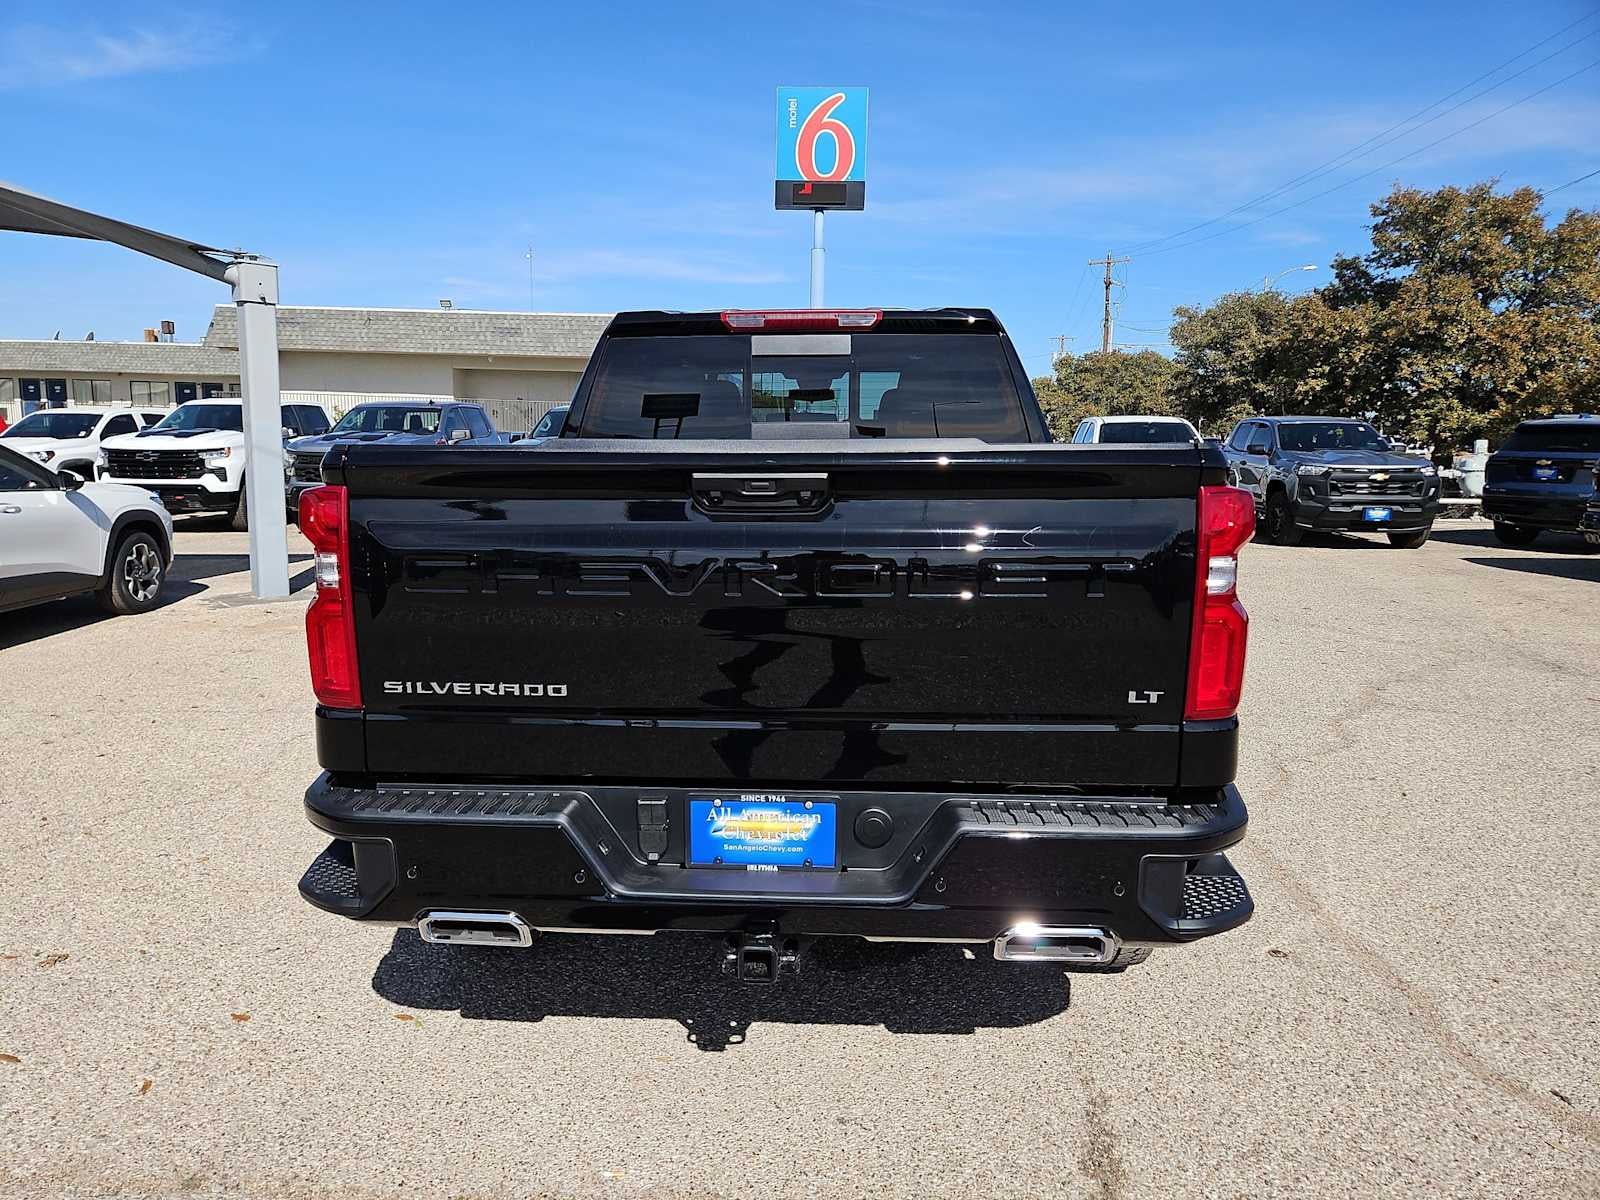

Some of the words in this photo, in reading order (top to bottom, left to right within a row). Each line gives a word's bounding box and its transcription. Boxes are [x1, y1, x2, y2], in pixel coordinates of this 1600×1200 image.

[788, 98, 798, 129] motel
[795, 92, 856, 181] 6
[402, 554, 1136, 599] CHEVROLET
[383, 681, 568, 697] SILVERADO
[1128, 690, 1165, 704] LT
[740, 794, 766, 802] SINCE
[706, 807, 732, 822] All
[738, 808, 822, 824] American
[721, 825, 809, 842] Chevrolet
[723, 843, 804, 853] SanAngeloChevy.com
